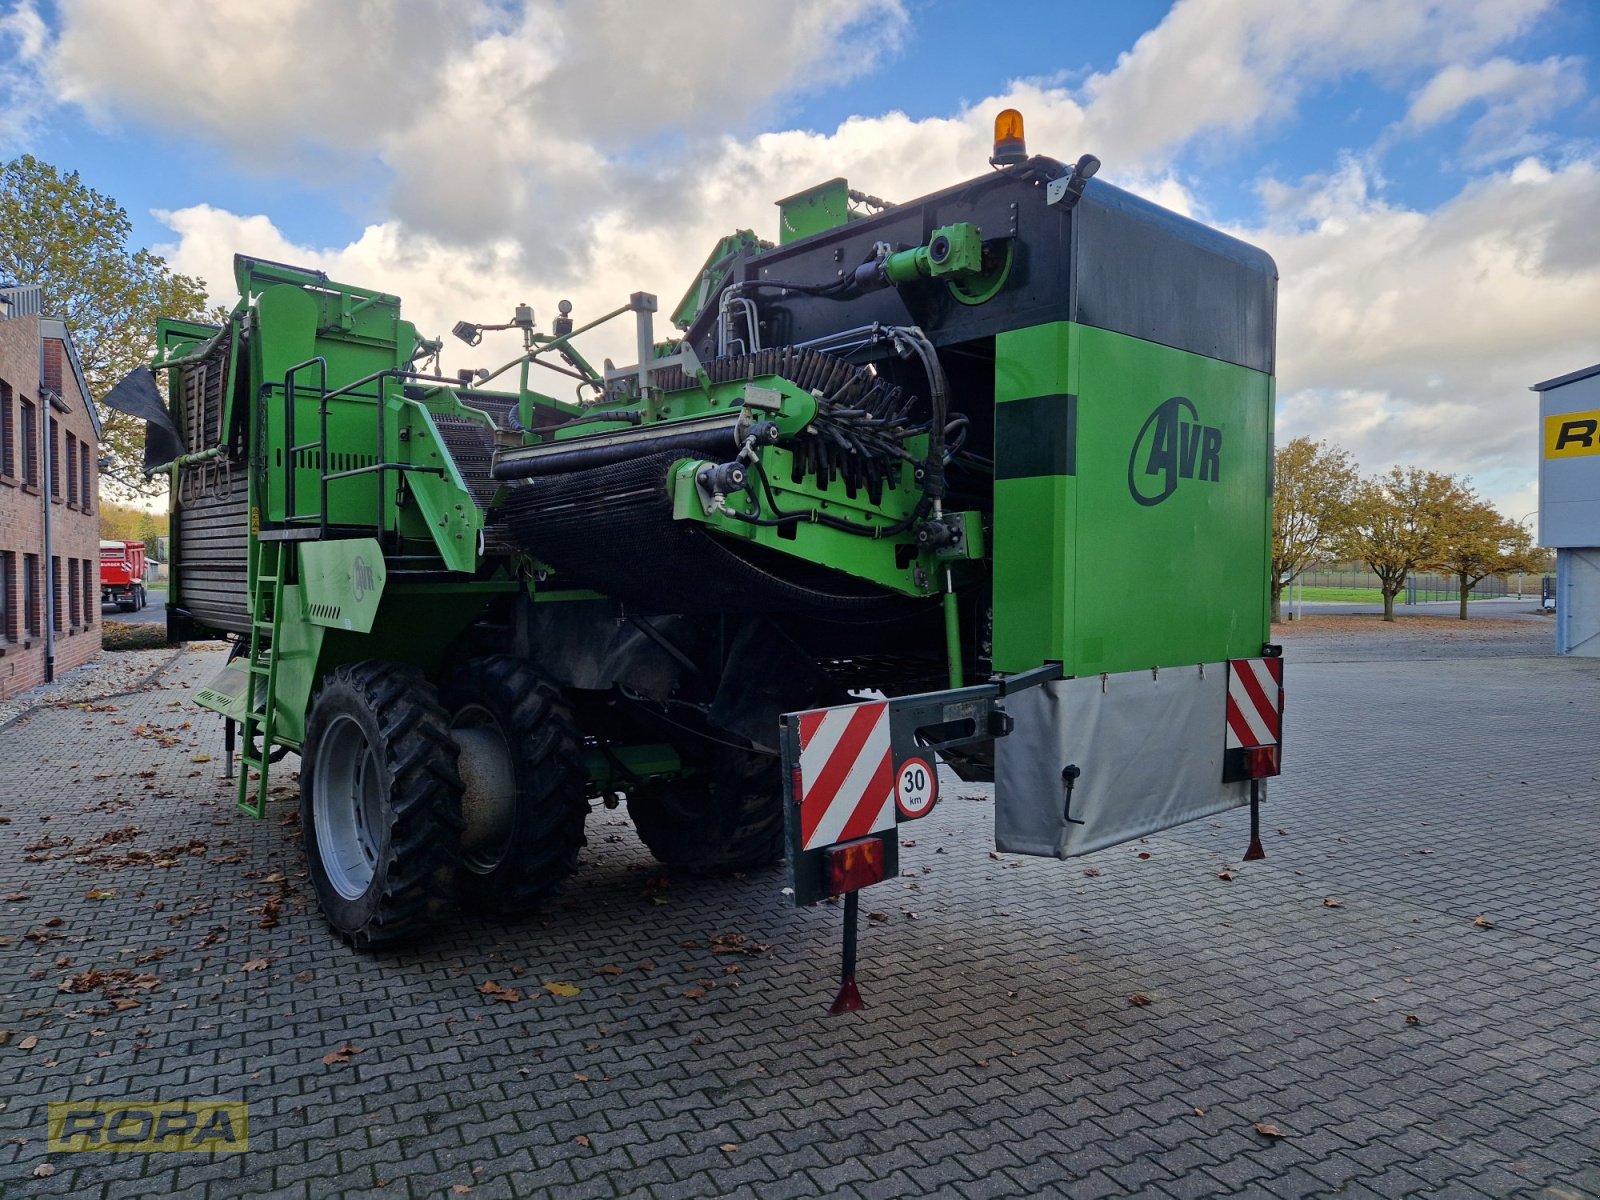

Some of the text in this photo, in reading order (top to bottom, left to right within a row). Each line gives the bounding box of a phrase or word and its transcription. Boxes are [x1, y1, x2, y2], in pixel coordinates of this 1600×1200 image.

[1555, 419, 1600, 450] R
[1127, 396, 1222, 507] AVR
[904, 769, 925, 793] 30
[909, 796, 922, 805] km
